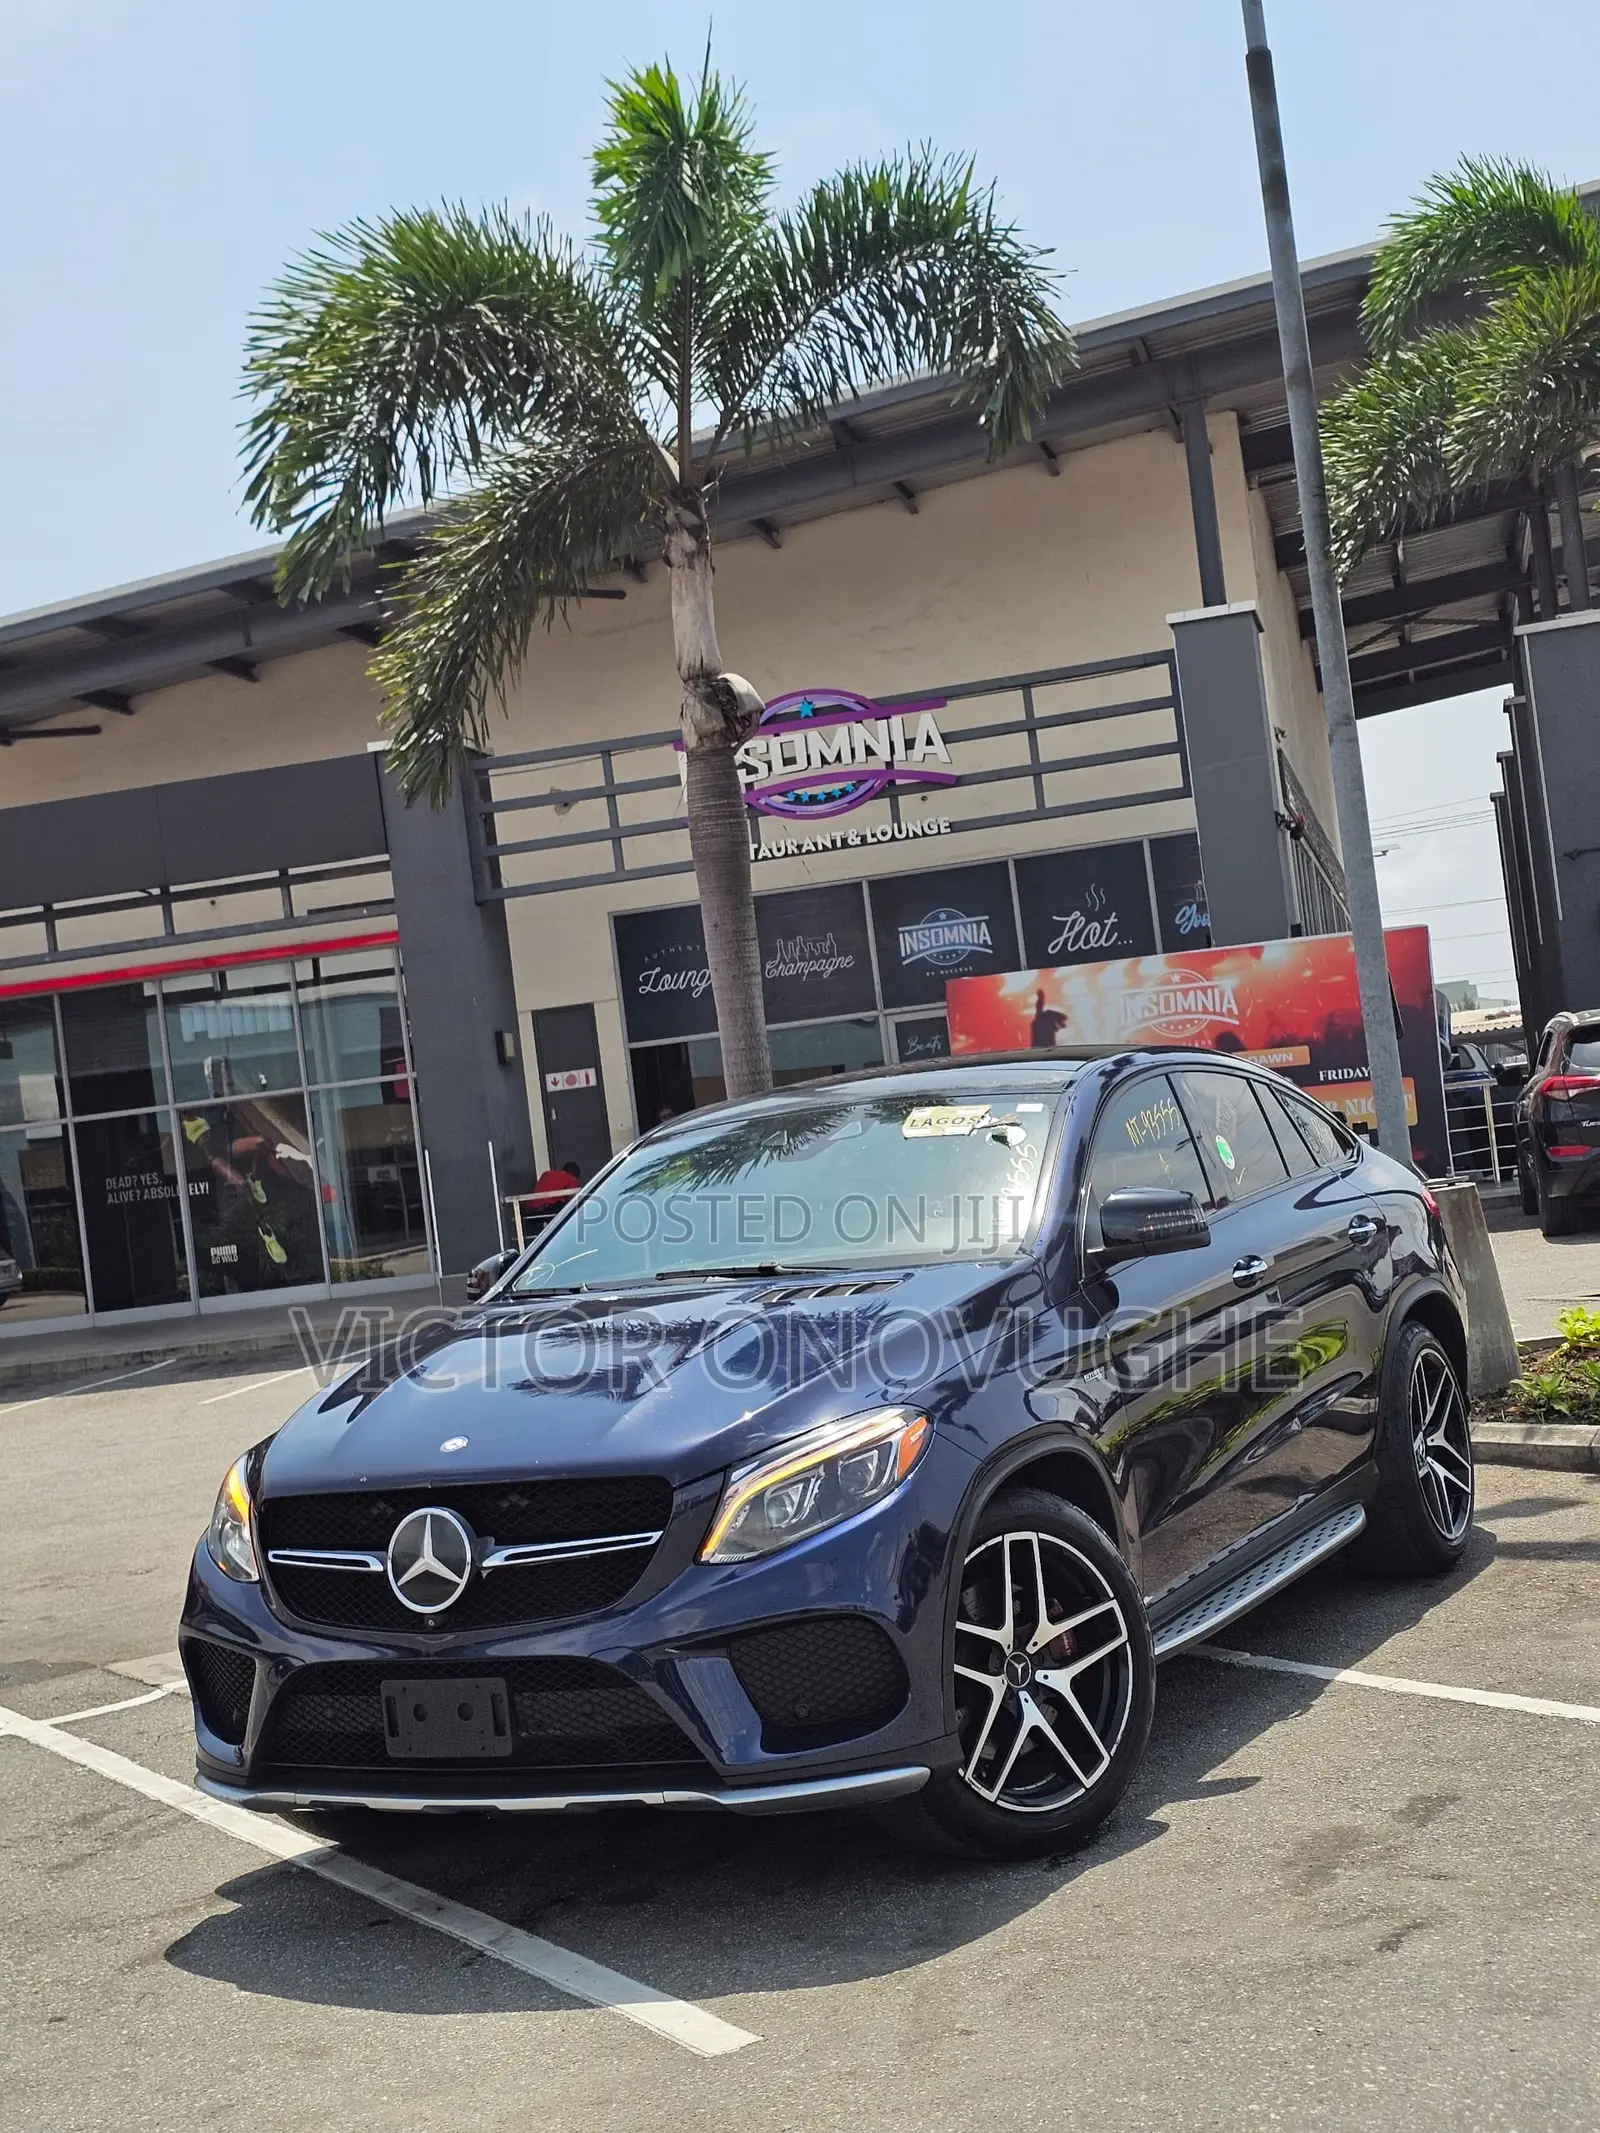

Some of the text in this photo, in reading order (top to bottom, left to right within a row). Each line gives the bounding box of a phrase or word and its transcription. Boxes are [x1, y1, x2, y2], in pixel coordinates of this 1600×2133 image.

[677, 713, 952, 803] SOMNIA
[750, 816, 951, 861] TAURANT & LOUNGE
[644, 944, 700, 963] AUTHENT
[899, 921, 993, 957] INSOMNIA
[639, 966, 712, 998] Loung
[765, 955, 855, 982] Champagne
[1120, 986, 1239, 1024] INSOMNIA
[1319, 1066, 1371, 1082] FRIDAY
[105, 1172, 163, 1190] DEAD? YES.
[107, 1182, 209, 1204] ALIVE? ABSOLELY!
